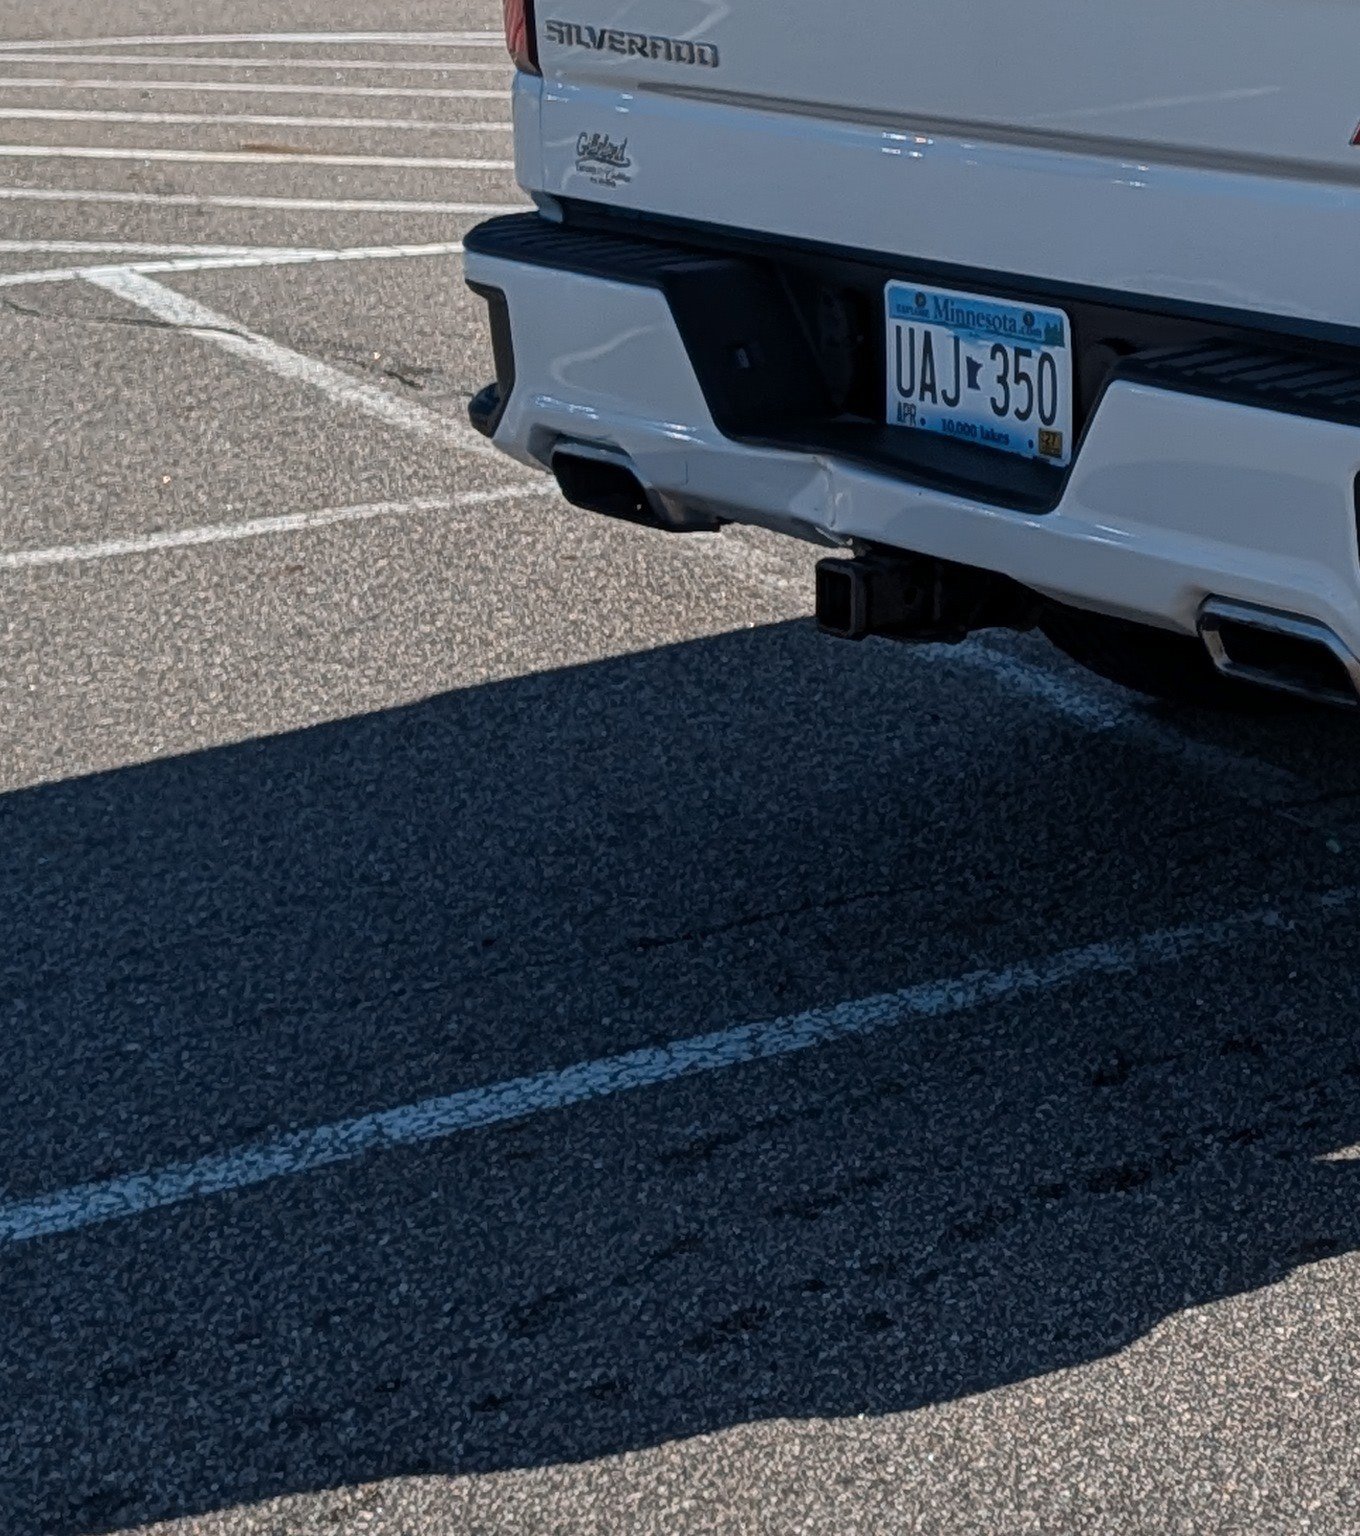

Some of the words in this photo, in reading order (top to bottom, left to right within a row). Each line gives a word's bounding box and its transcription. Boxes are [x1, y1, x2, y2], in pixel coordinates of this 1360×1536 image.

[545, 19, 721, 68] SILVERADO
[933, 296, 1017, 333] Minnesota
[896, 325, 961, 408] UAJ
[990, 343, 1058, 427] 350
[980, 425, 1010, 446] lakes
